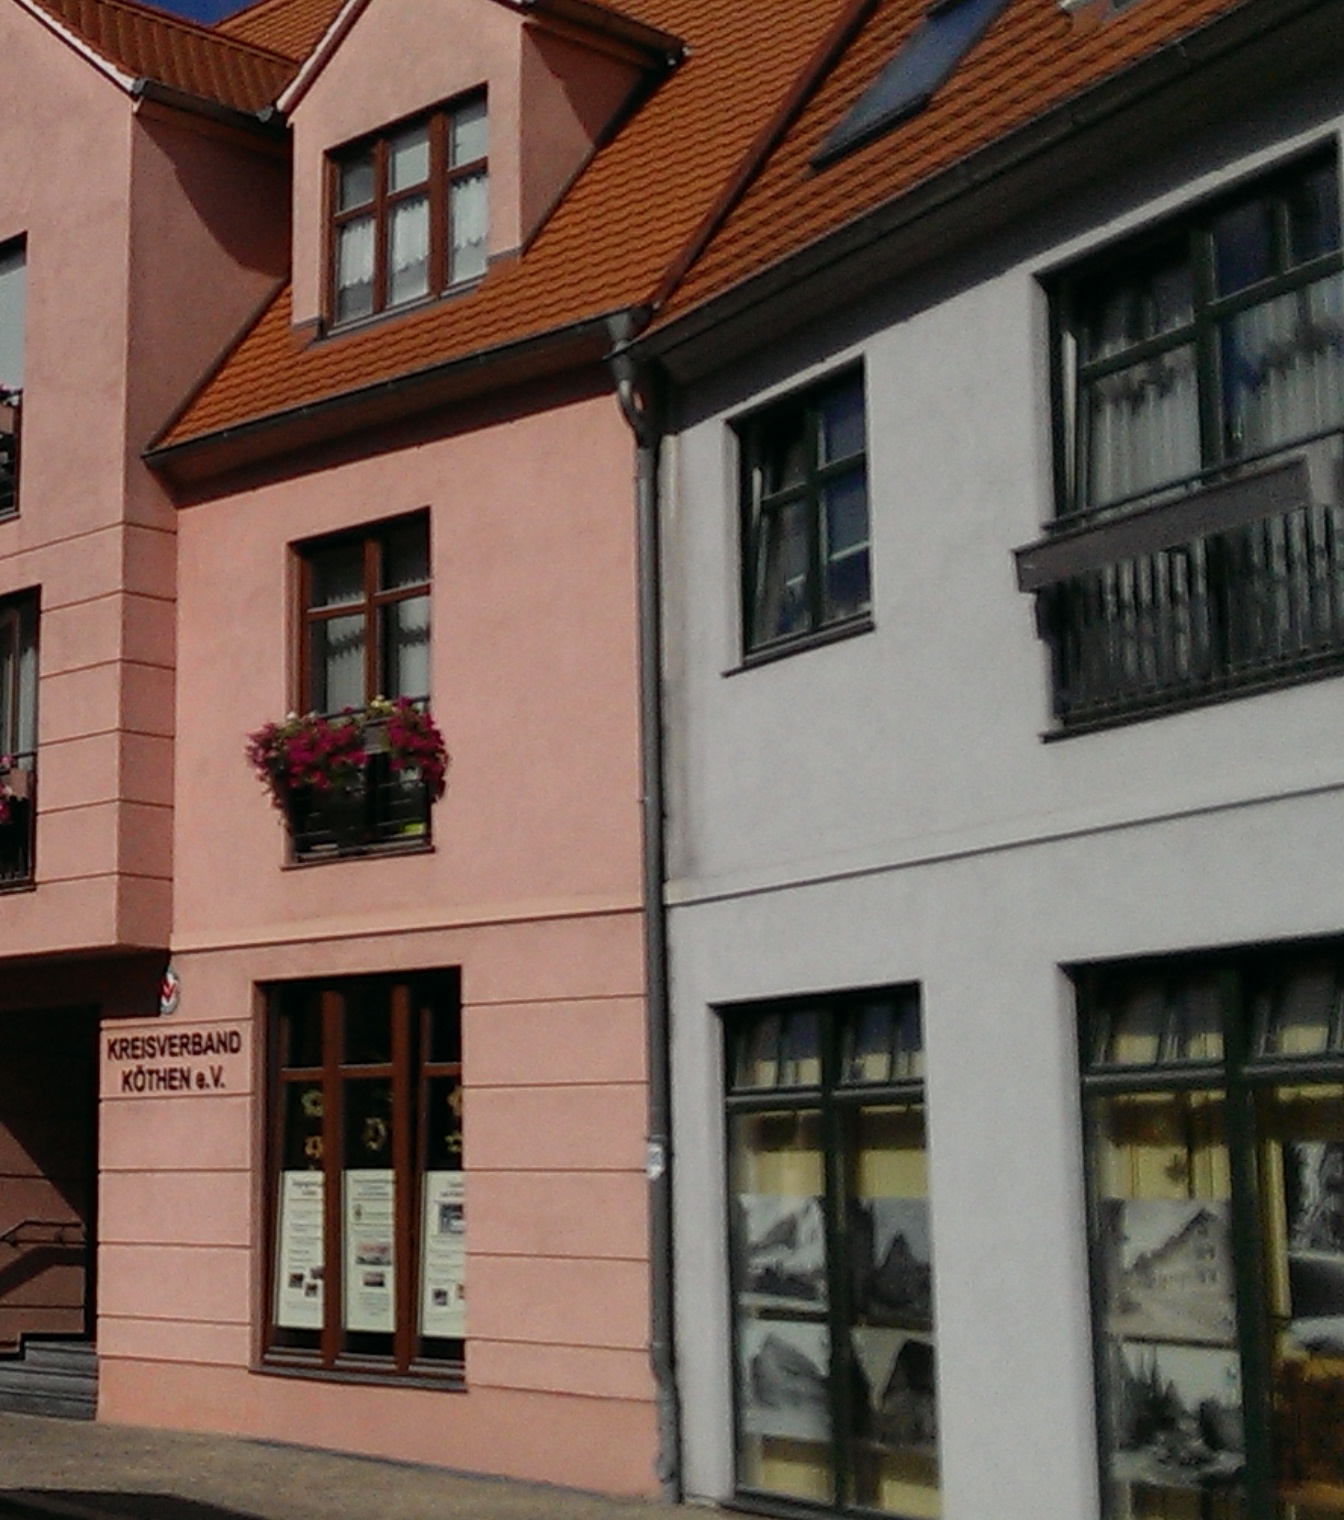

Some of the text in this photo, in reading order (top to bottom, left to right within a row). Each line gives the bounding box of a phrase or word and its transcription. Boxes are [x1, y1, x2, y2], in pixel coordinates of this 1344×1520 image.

[107, 1029, 242, 1060] KREISVERBAND
[121, 1064, 226, 1093] KÖTHEN e.V.
